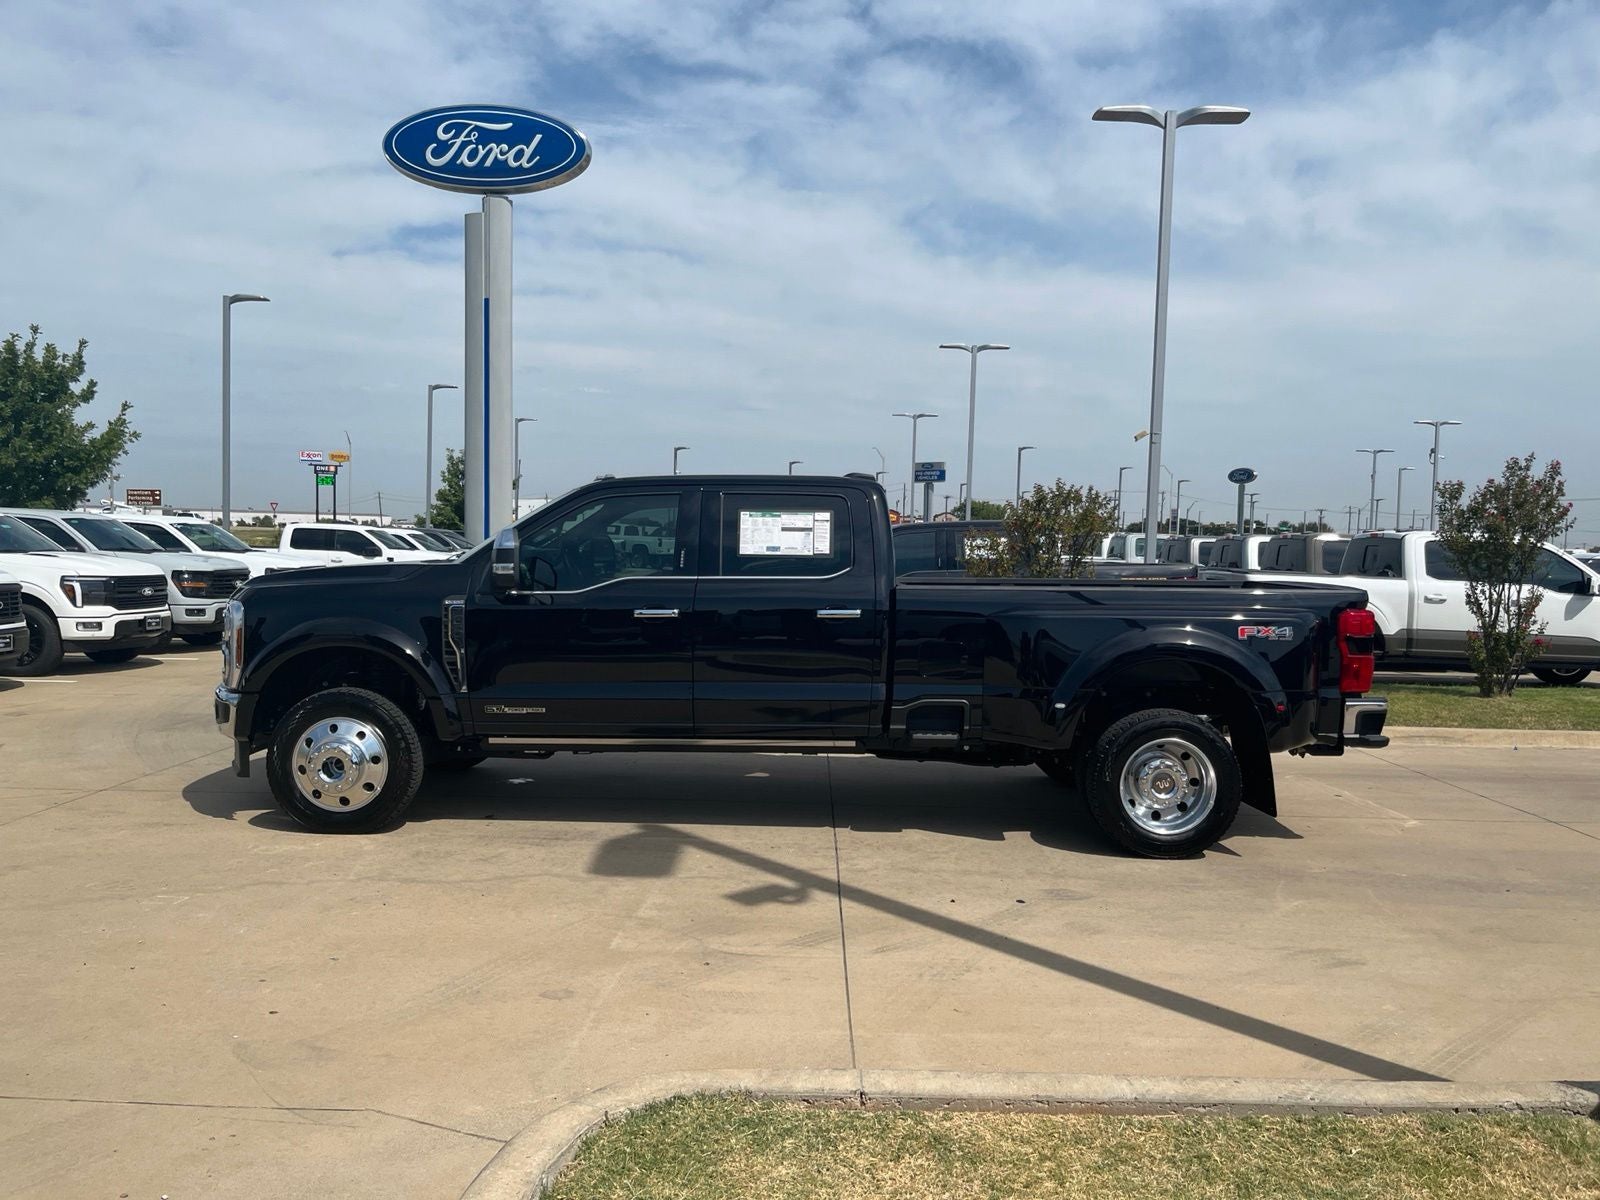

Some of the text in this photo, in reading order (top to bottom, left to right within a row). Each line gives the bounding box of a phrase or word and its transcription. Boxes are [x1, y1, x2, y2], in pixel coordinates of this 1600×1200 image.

[425, 119, 542, 168] Ford
[301, 451, 322, 460] Exxon
[1238, 626, 1292, 640] FX4
